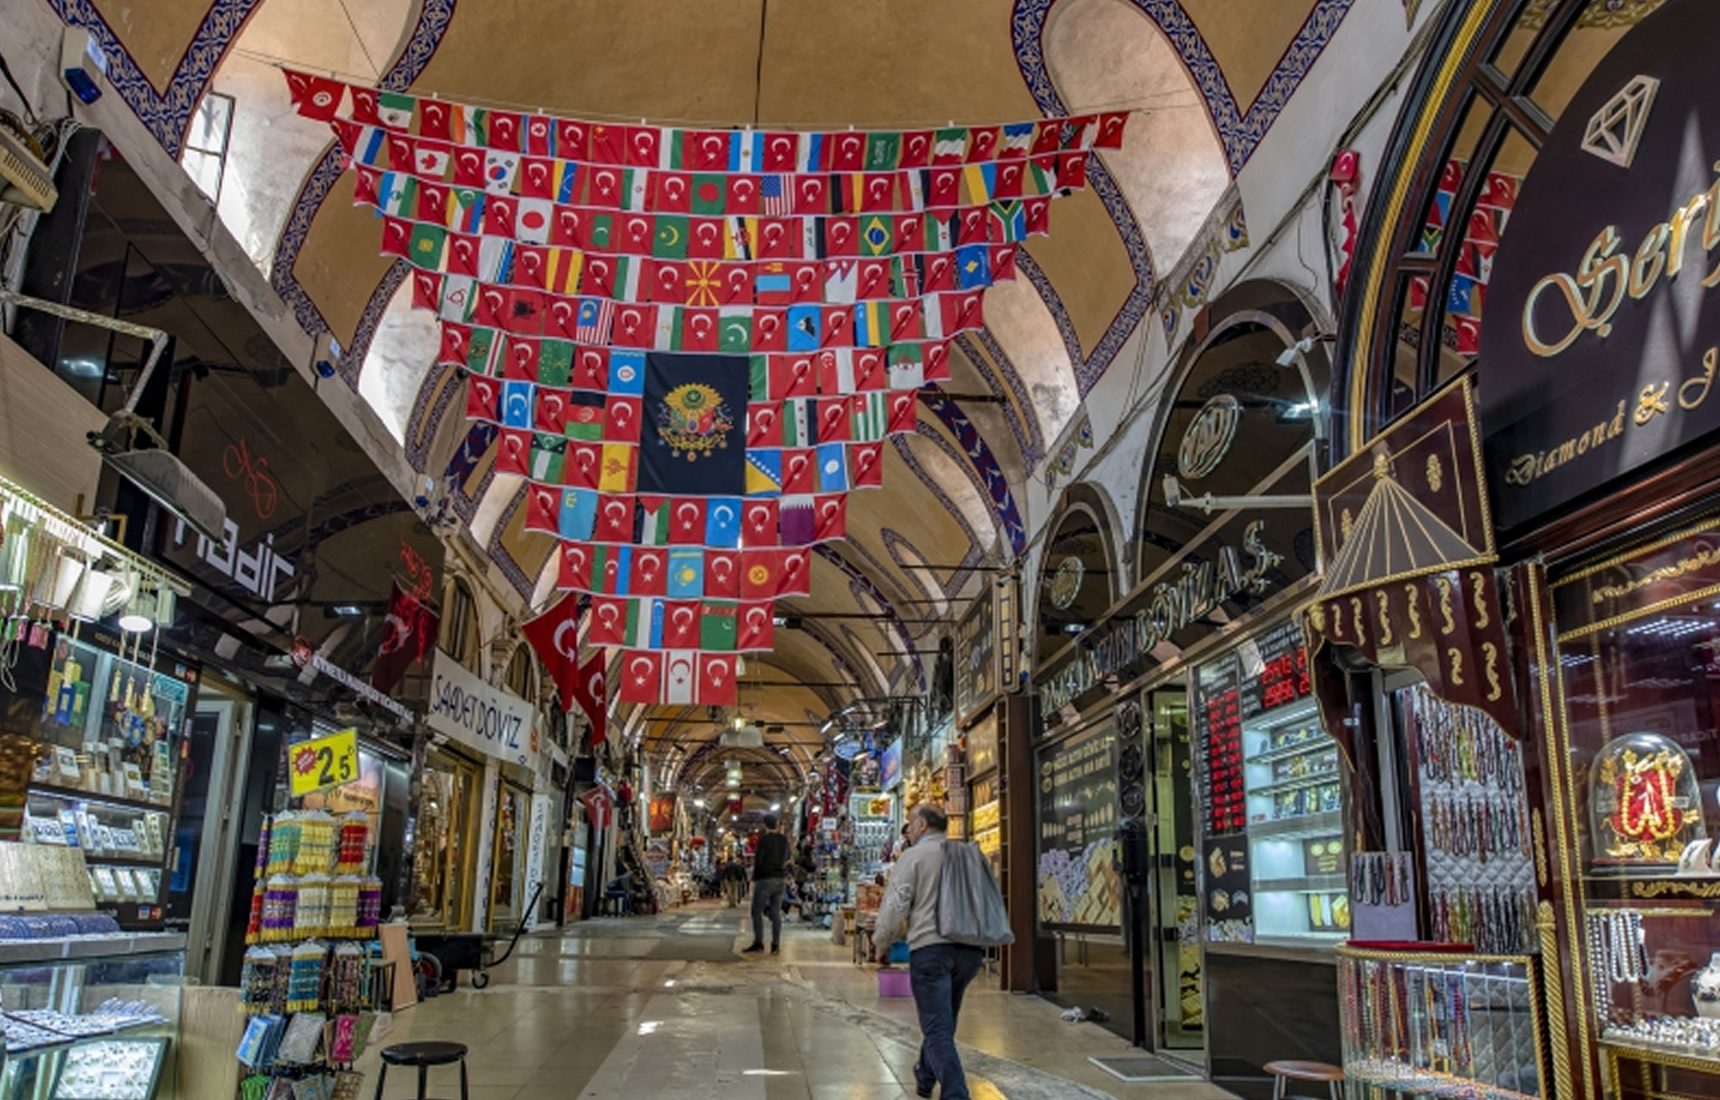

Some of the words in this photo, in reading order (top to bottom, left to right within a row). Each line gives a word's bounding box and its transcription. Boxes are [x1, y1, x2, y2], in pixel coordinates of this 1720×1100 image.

[1505, 399, 1627, 486] Diamond
[1634, 382, 1669, 424] &
[1678, 346, 1720, 409] J
[476, 697, 522, 750] DÖVİZ
